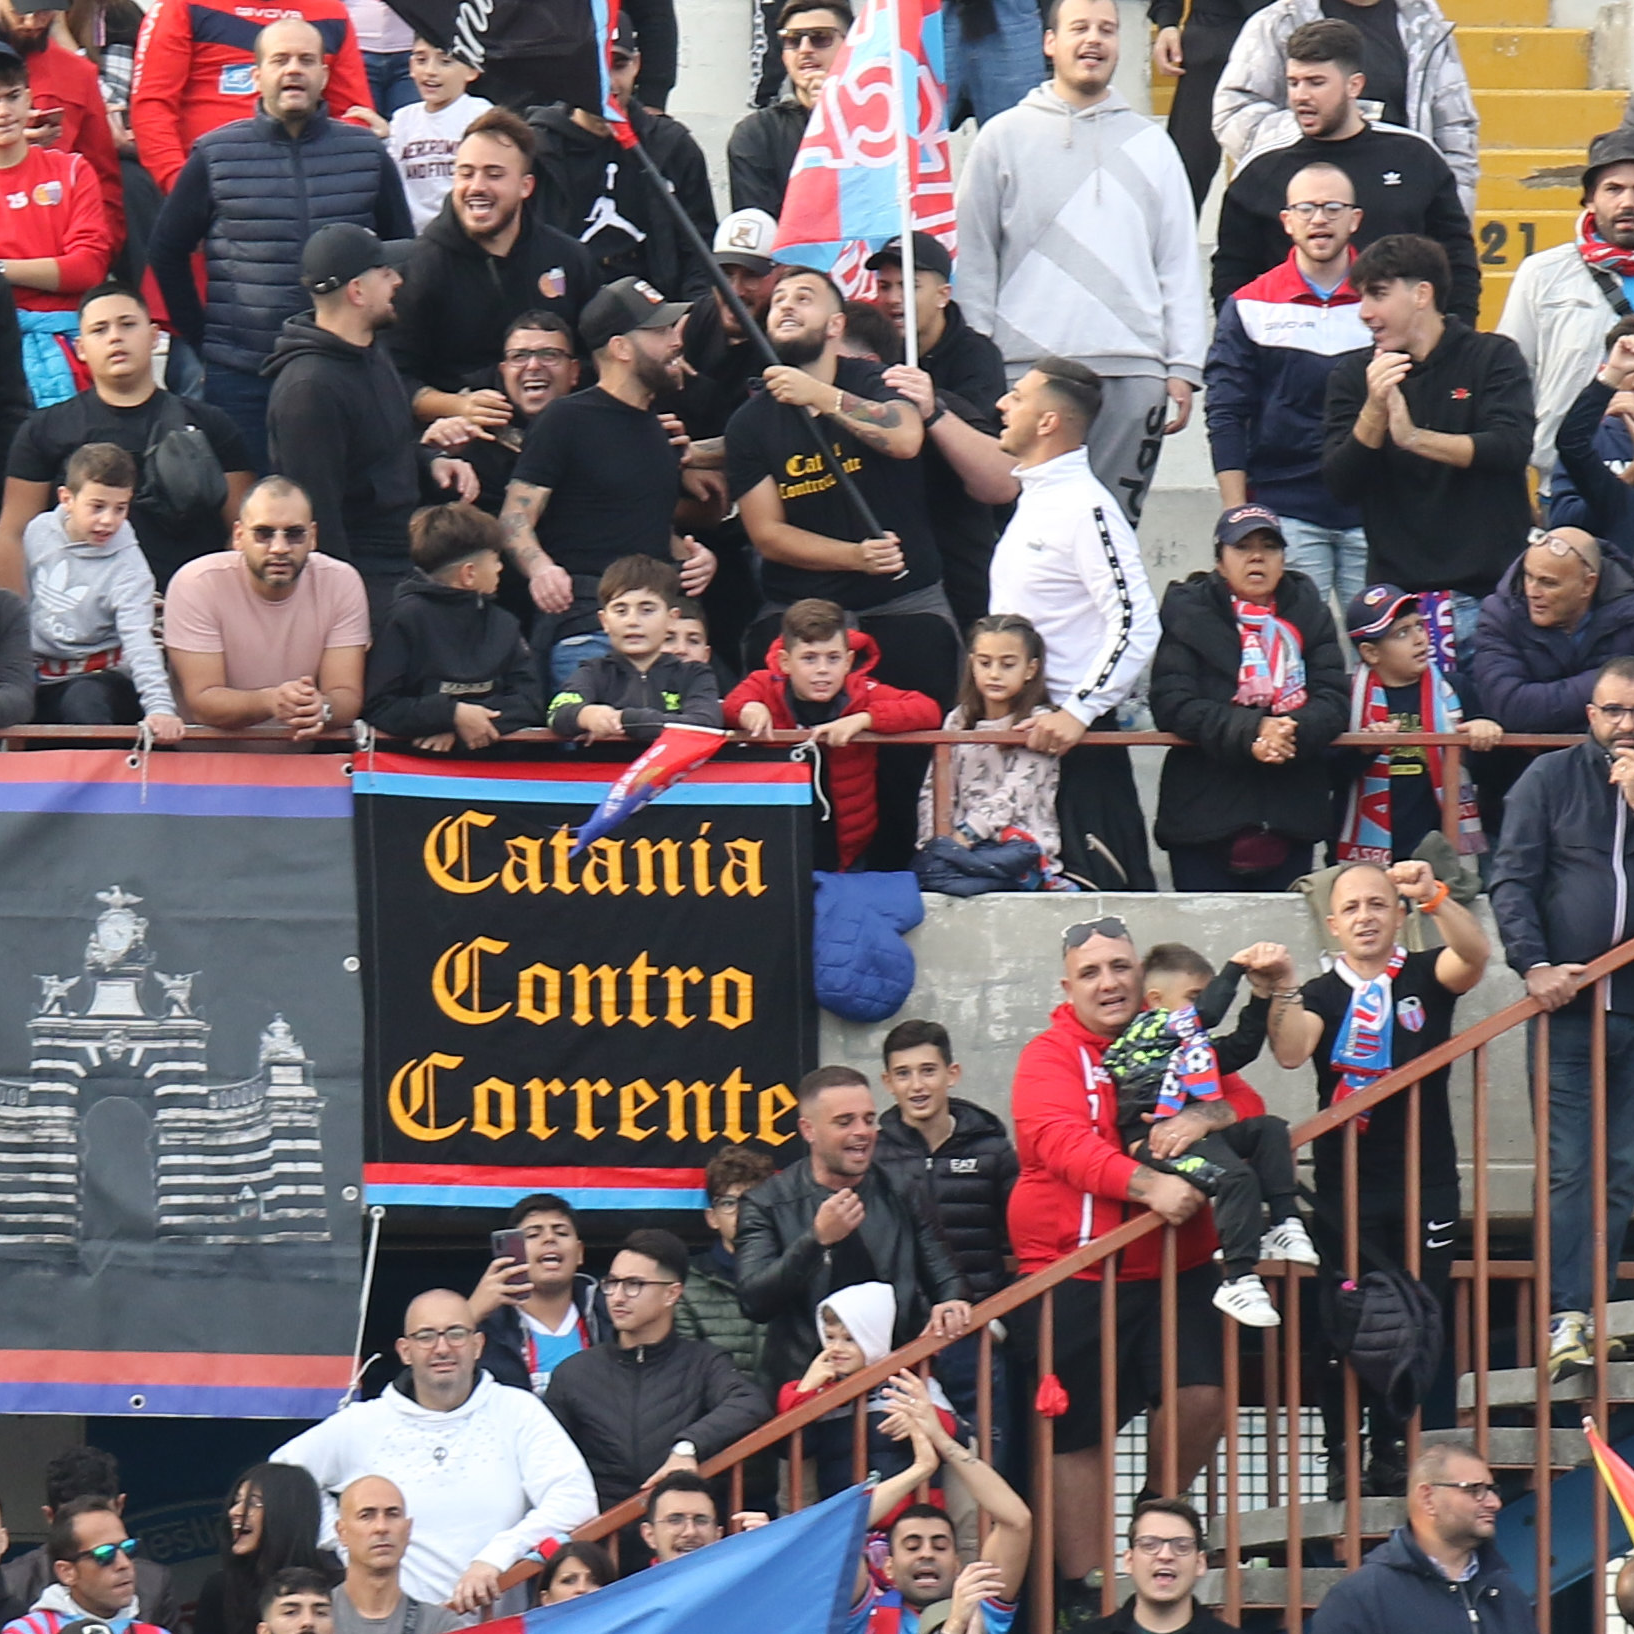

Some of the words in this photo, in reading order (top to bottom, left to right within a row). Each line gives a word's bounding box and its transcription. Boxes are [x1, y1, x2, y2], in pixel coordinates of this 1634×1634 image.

[424, 810, 769, 898] Catania
[431, 935, 754, 1030] Contro
[387, 1052, 799, 1146] Corrente
